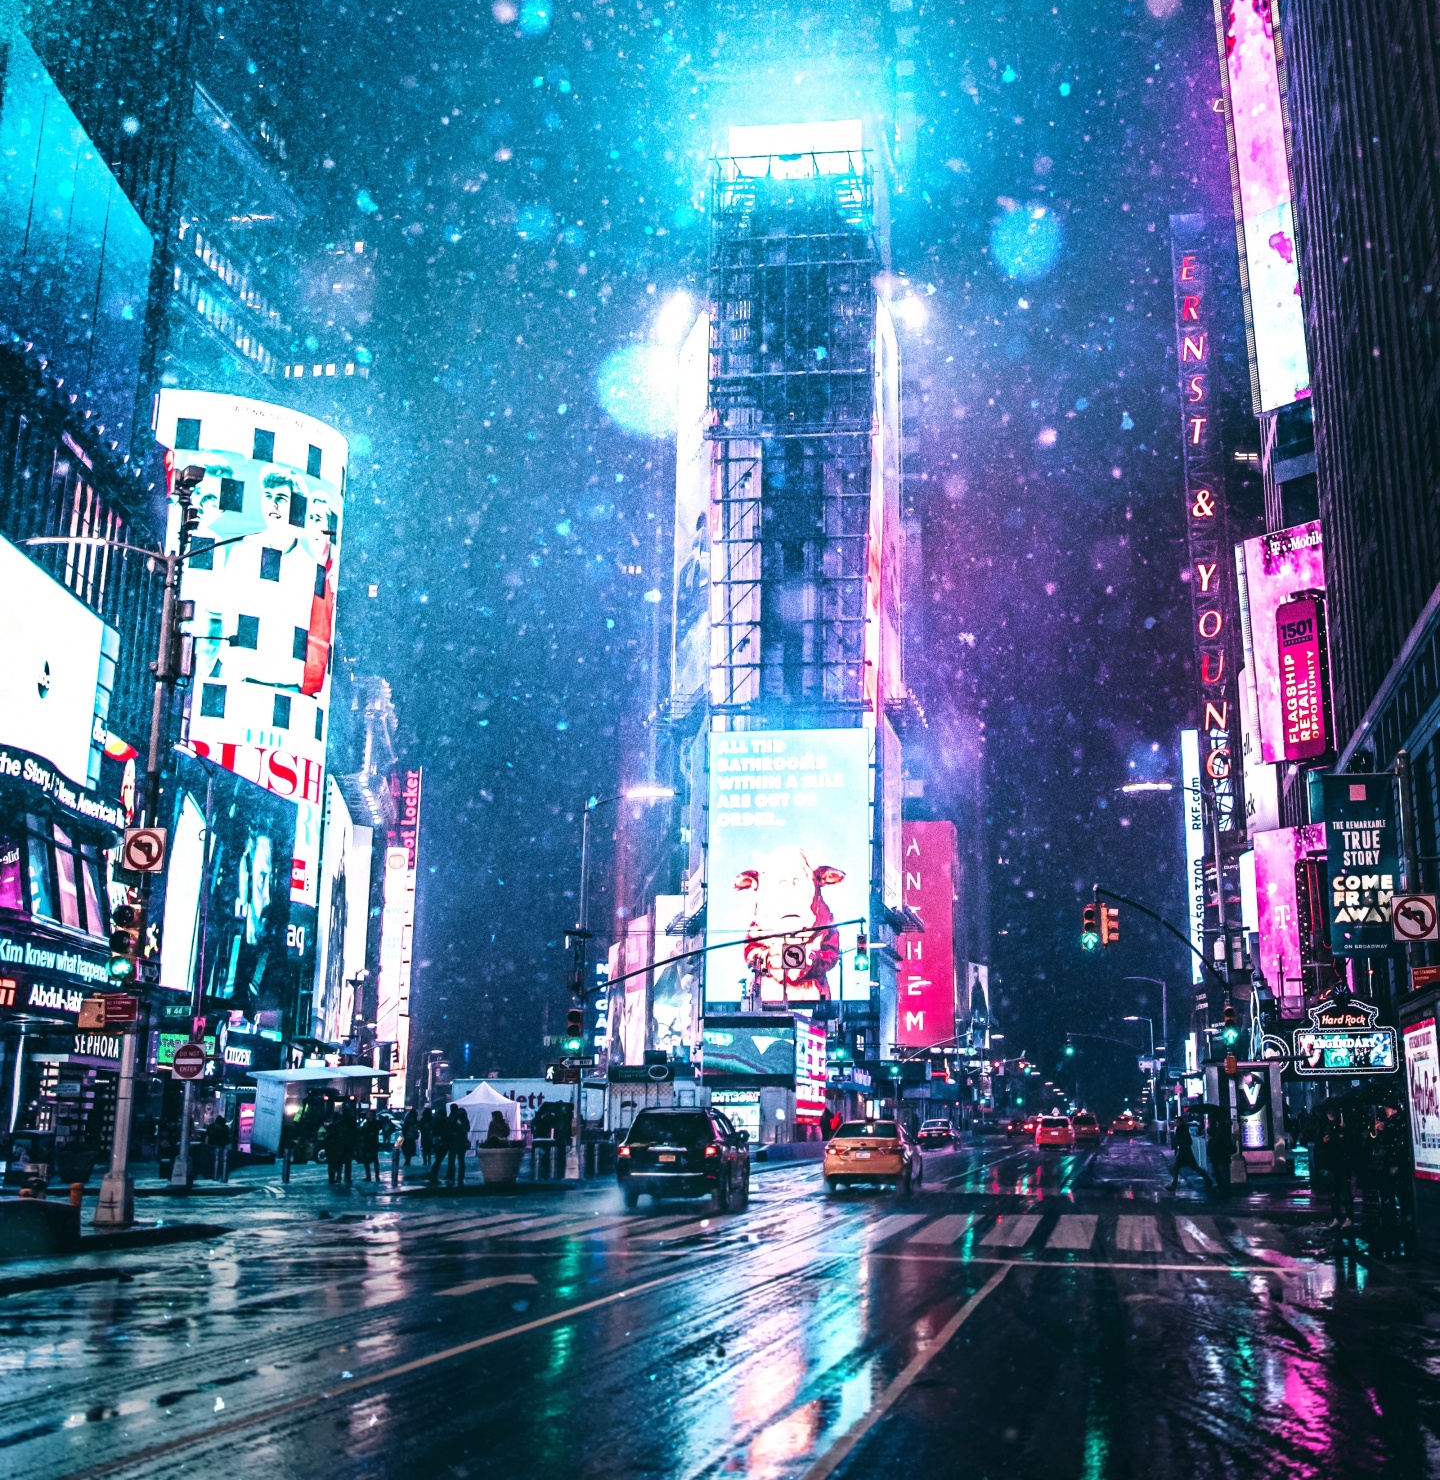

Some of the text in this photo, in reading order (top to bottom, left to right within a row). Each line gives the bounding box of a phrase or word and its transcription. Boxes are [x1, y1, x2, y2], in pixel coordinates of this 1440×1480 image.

[1180, 255, 1231, 779] ERNST & YOUNG
[1281, 618, 1313, 640] 1501
[1284, 654, 1300, 744] FLAGSHIP
[1306, 650, 1320, 739] OPPORTUNITY
[1297, 679, 1311, 742] RETAIL
[717, 738, 786, 754] ALL THE
[717, 756, 827, 772] BATHROOMS
[717, 773, 844, 790] WITHIN A MILE
[401, 770, 419, 826] Locker
[717, 792, 817, 808] ARE OUT OF
[1191, 776, 1202, 831] RKF.com
[1332, 819, 1386, 830] THE REMARKABLE
[1342, 829, 1380, 850] TRUE
[1343, 850, 1380, 866] STORY
[1332, 874, 1393, 891] COME
[1333, 907, 1391, 924] AWAY
[24, 942, 56, 969] knew
[56, 949, 78, 974] what
[1321, 1014, 1366, 1026] Hard Rock
[74, 1034, 119, 1059] SEPHORA
